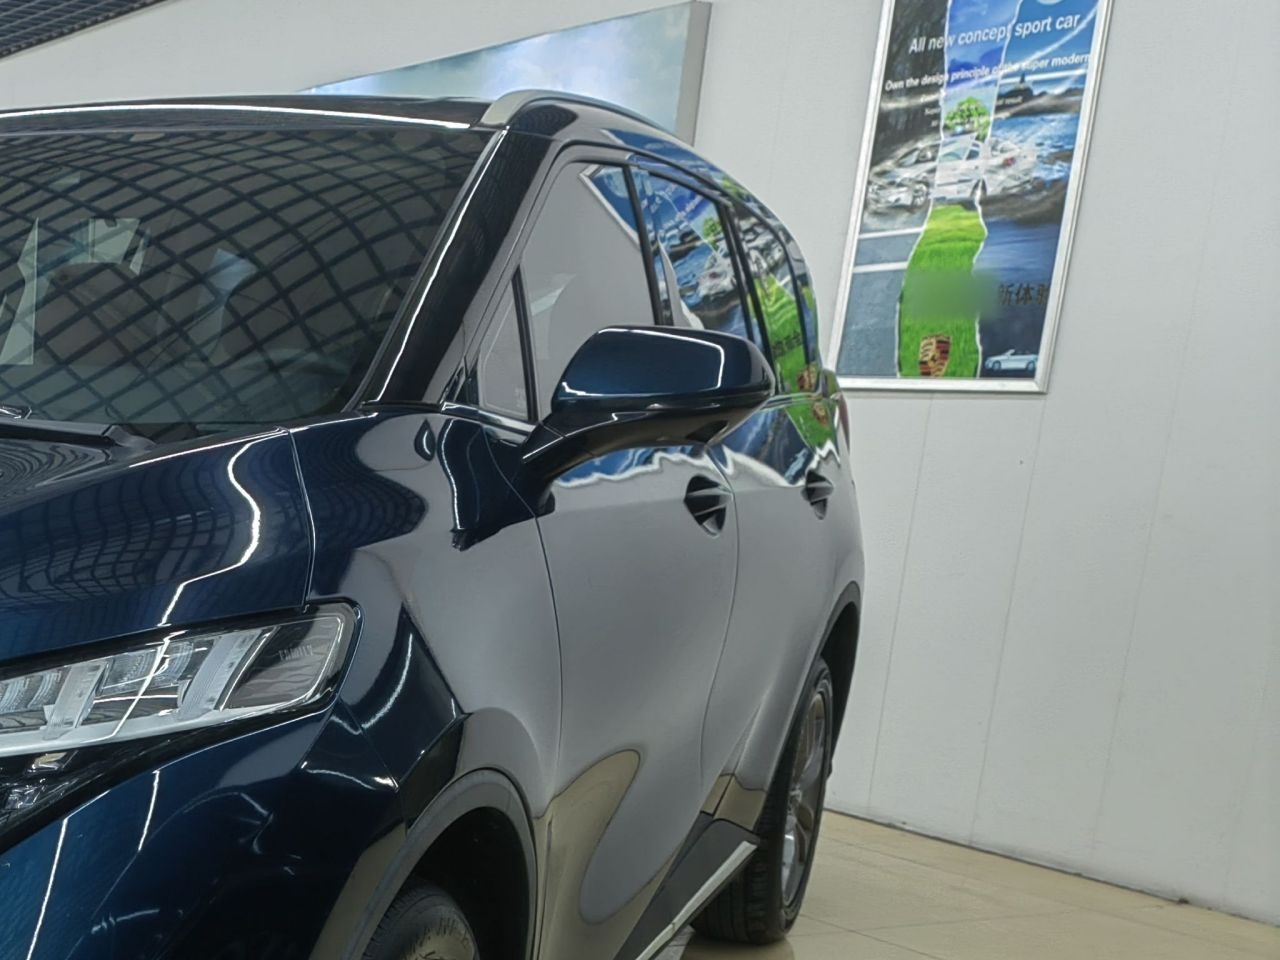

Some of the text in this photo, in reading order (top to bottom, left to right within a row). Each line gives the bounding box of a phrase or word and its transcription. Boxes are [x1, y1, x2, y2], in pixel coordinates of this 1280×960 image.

[909, 13, 1081, 54] All new concept sport car
[885, 80, 904, 91] Own
[906, 77, 919, 88] the
[920, 72, 948, 85] design
[950, 65, 991, 82] principle
